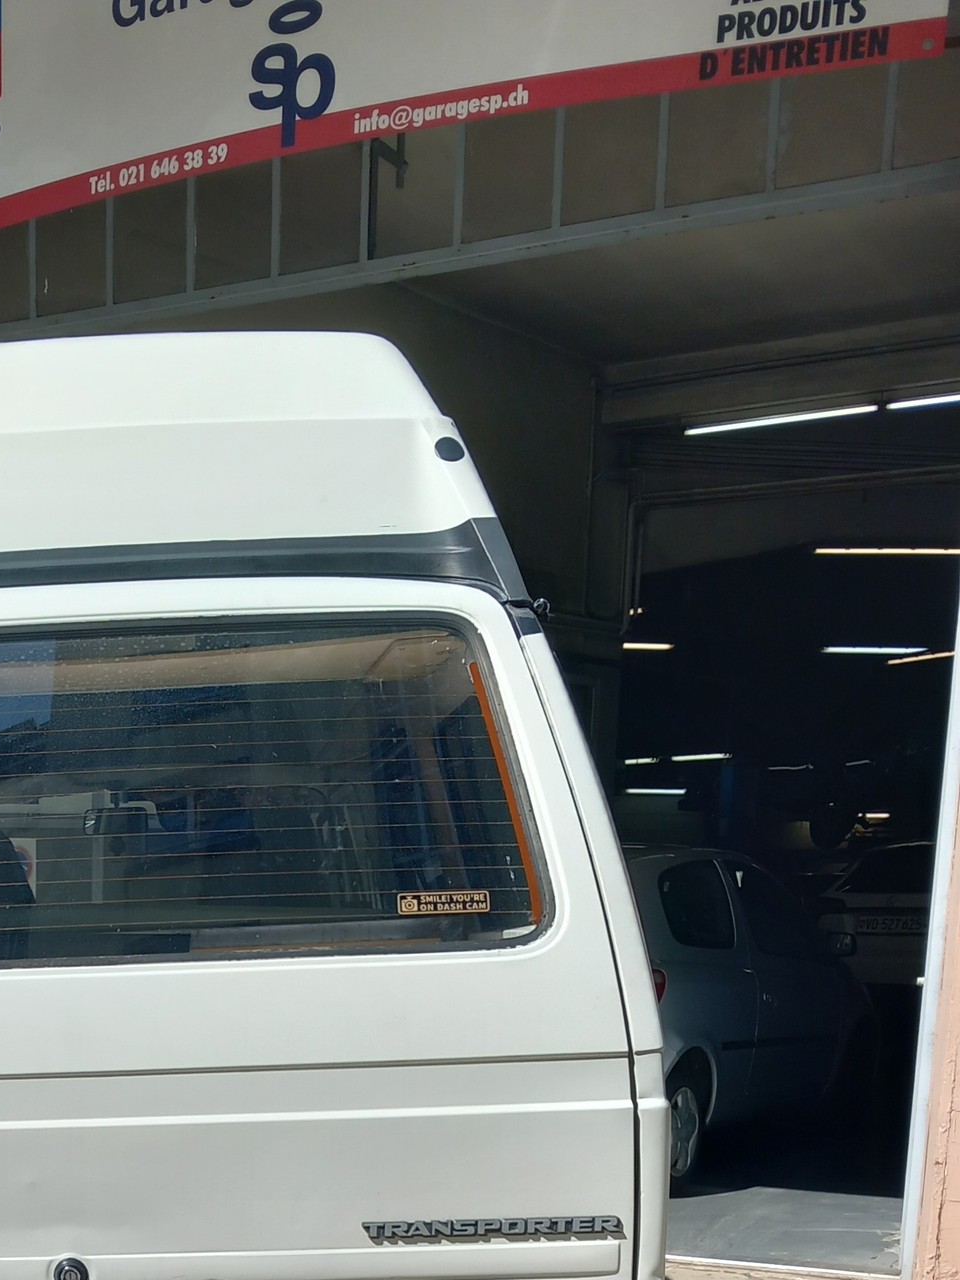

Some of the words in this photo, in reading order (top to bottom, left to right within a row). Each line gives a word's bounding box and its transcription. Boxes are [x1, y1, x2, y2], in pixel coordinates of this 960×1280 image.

[717, 0, 867, 43] PRODUITS
[353, 83, 529, 134] info@garagesp.ch
[89, 171, 115, 195] Tél.
[119, 163, 145, 187] 021
[150, 155, 179, 179] 646
[183, 149, 203, 171] 38
[207, 143, 228, 165] 39
[420, 895, 450, 903] SMILE!
[452, 893, 485, 902] YOU'RE
[420, 903, 434, 911] ON
[437, 903, 463, 911] DASH
[361, 1216, 623, 1238] TRANSPORTER
